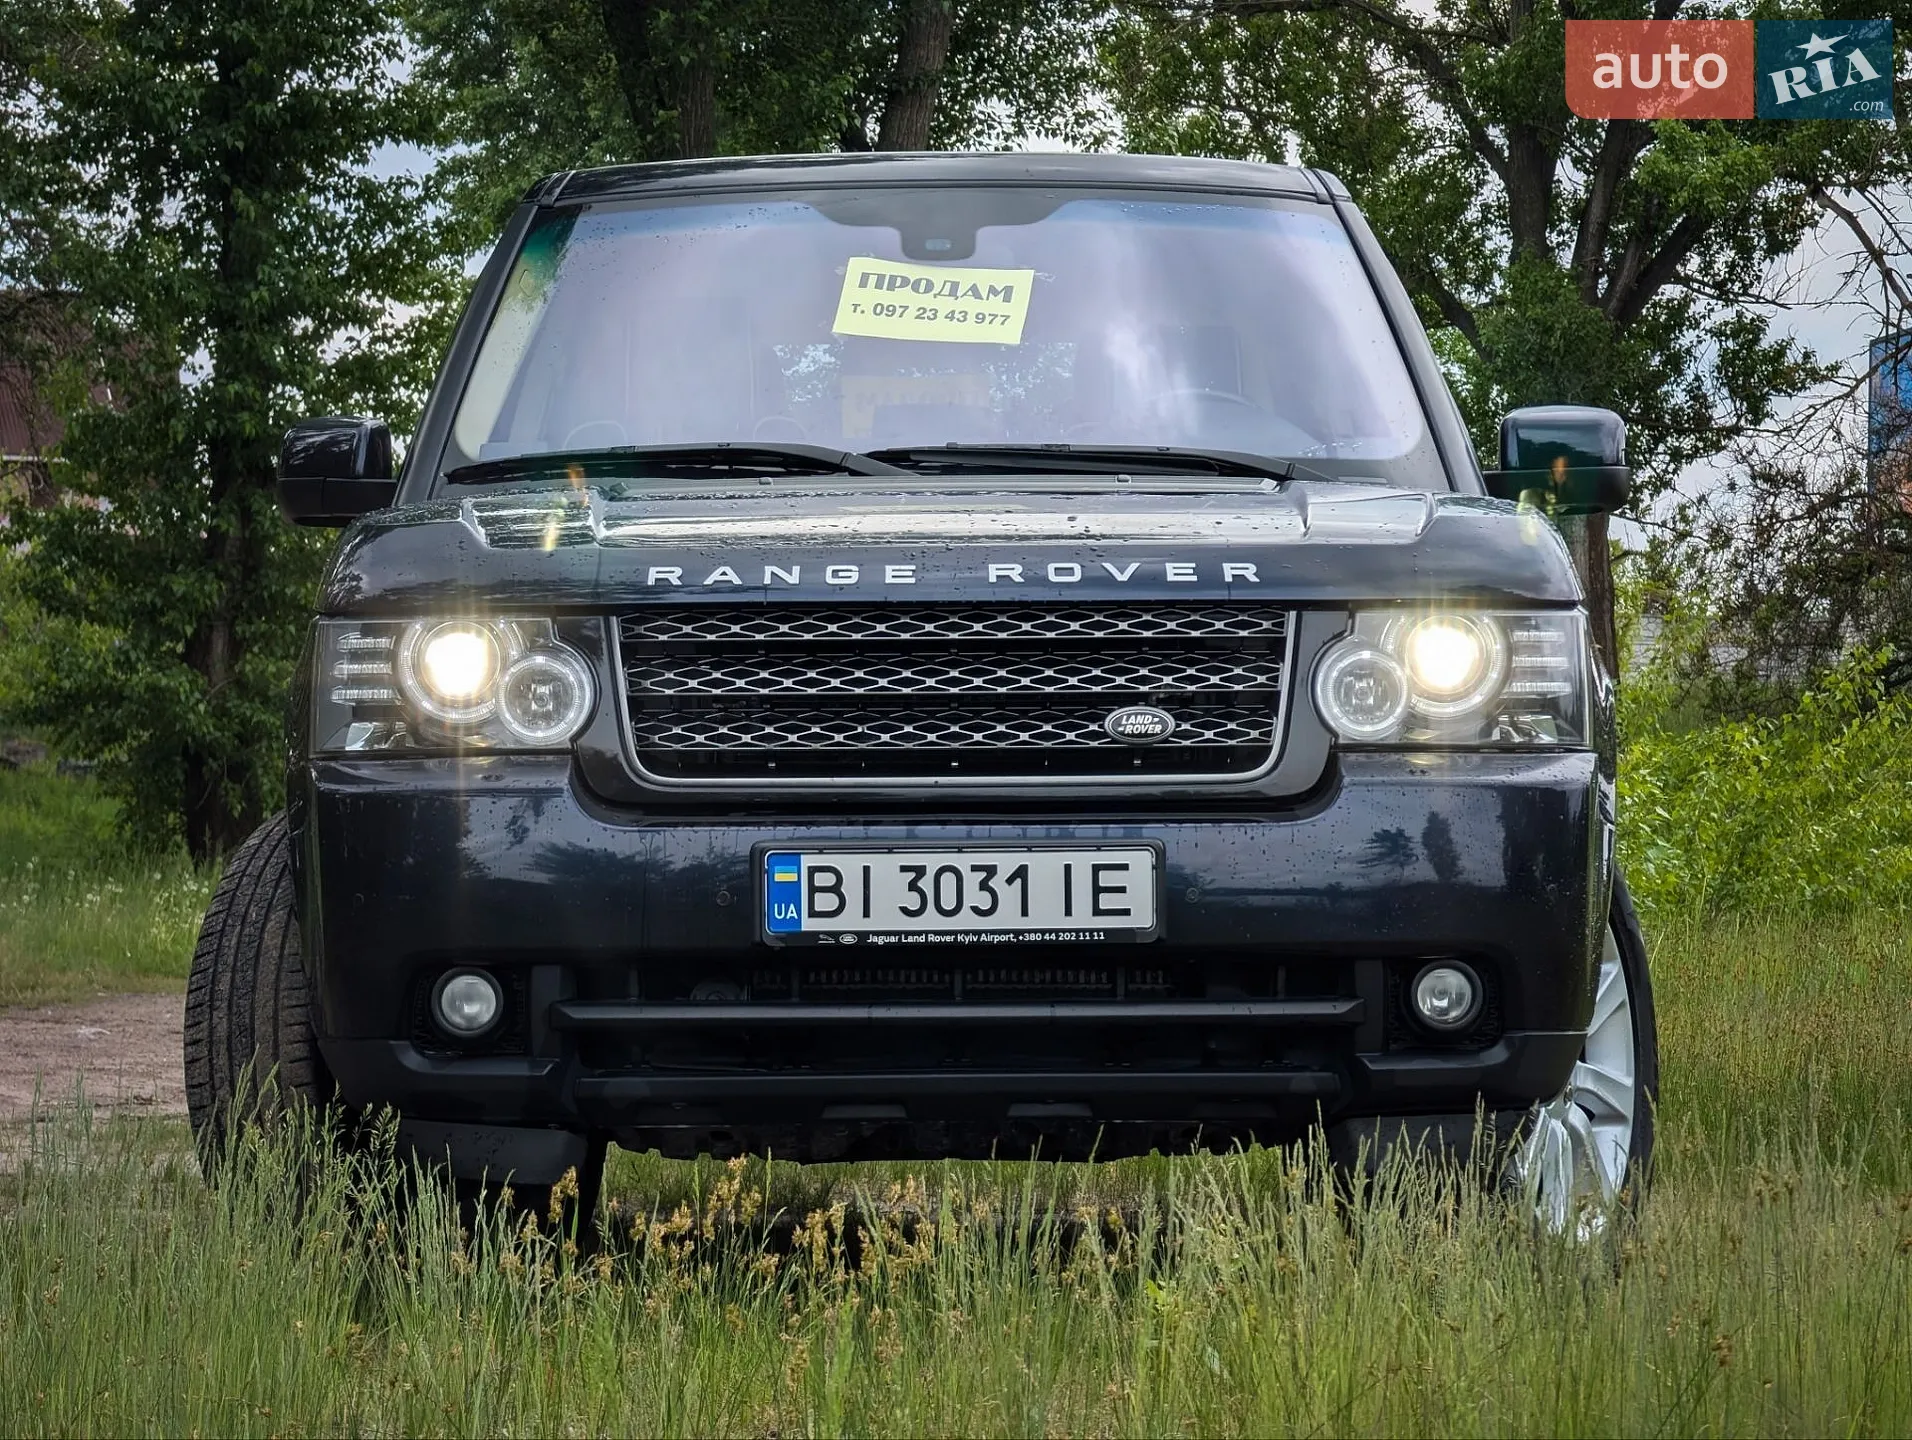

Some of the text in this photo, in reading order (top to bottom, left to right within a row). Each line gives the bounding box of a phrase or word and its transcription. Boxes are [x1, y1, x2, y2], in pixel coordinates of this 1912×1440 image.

[858, 271, 1014, 303] ПРОДАМ
[872, 302, 909, 318] 097
[914, 306, 939, 321] 23
[944, 310, 968, 323] 43
[974, 312, 1011, 326] 977
[646, 562, 1261, 586] RANGE ROVER
[807, 863, 1132, 919] BI 3031 IE
[774, 903, 798, 920] UA
[867, 933, 899, 945] Jaguar
[902, 933, 926, 943] Land
[928, 933, 955, 943] Rover
[957, 933, 979, 945] Kyiv
[980, 932, 1017, 944] Airport,
[1018, 932, 1042, 941] +380
[1043, 932, 1057, 941] 44
[1058, 931, 1077, 941] 202
[1078, 931, 1091, 940] 11
[1093, 931, 1105, 940] 11
